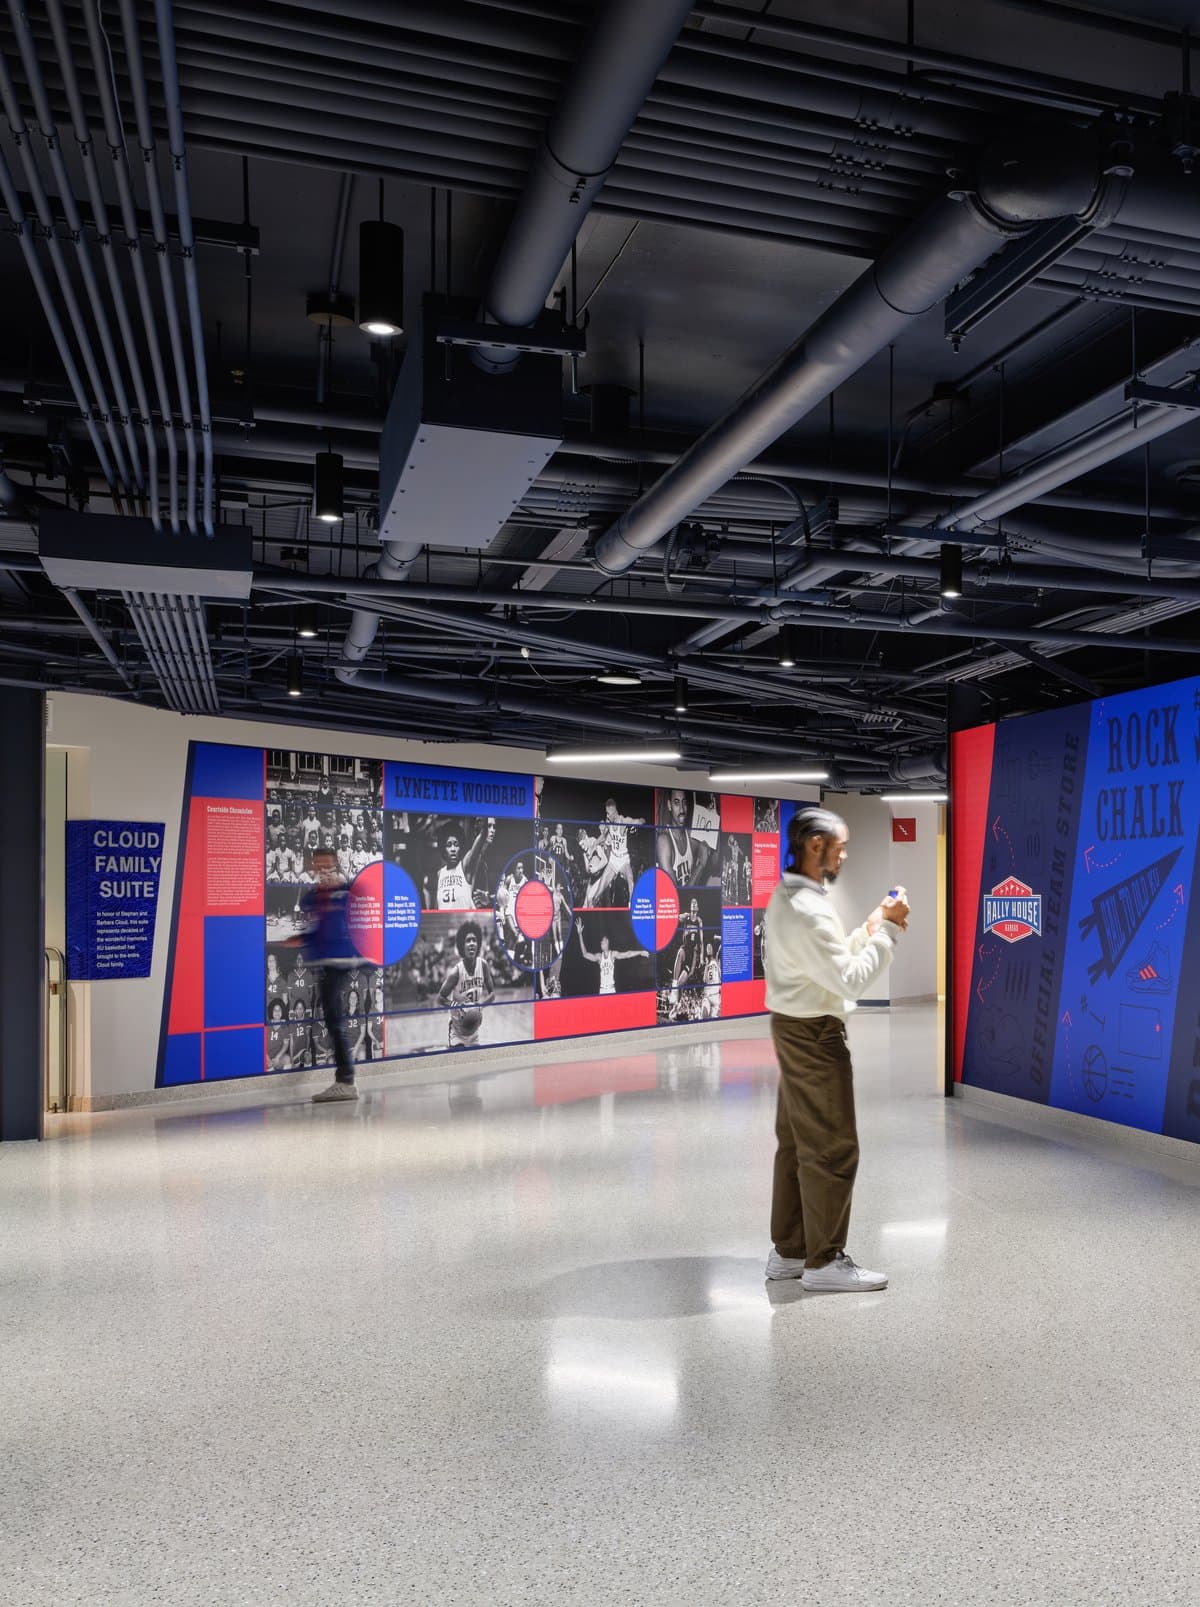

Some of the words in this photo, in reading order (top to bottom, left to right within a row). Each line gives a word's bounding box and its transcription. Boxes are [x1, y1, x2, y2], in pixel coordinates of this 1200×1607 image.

[1106, 703, 1180, 773] ROCK
[395, 776, 458, 801] LYNETTE
[462, 782, 526, 806] WOODARD
[1055, 732, 1080, 837] STORE
[1096, 779, 1185, 842] CHALK
[94, 830, 160, 849] CLOUD
[95, 856, 161, 873] FAMILY
[99, 881, 155, 898] SUITE
[442, 888, 456, 902] 31
[1045, 848, 1067, 937] TEAM
[986, 901, 1010, 925] RALLY
[1011, 901, 1039, 926] HOUSE
[268, 984, 277, 993] 42
[295, 979, 305, 988] 40
[349, 1018, 358, 1028] 32
[1029, 947, 1056, 1087] OFFICIAL
[270, 1031, 279, 1041] 14
[296, 1026, 305, 1037] 12
